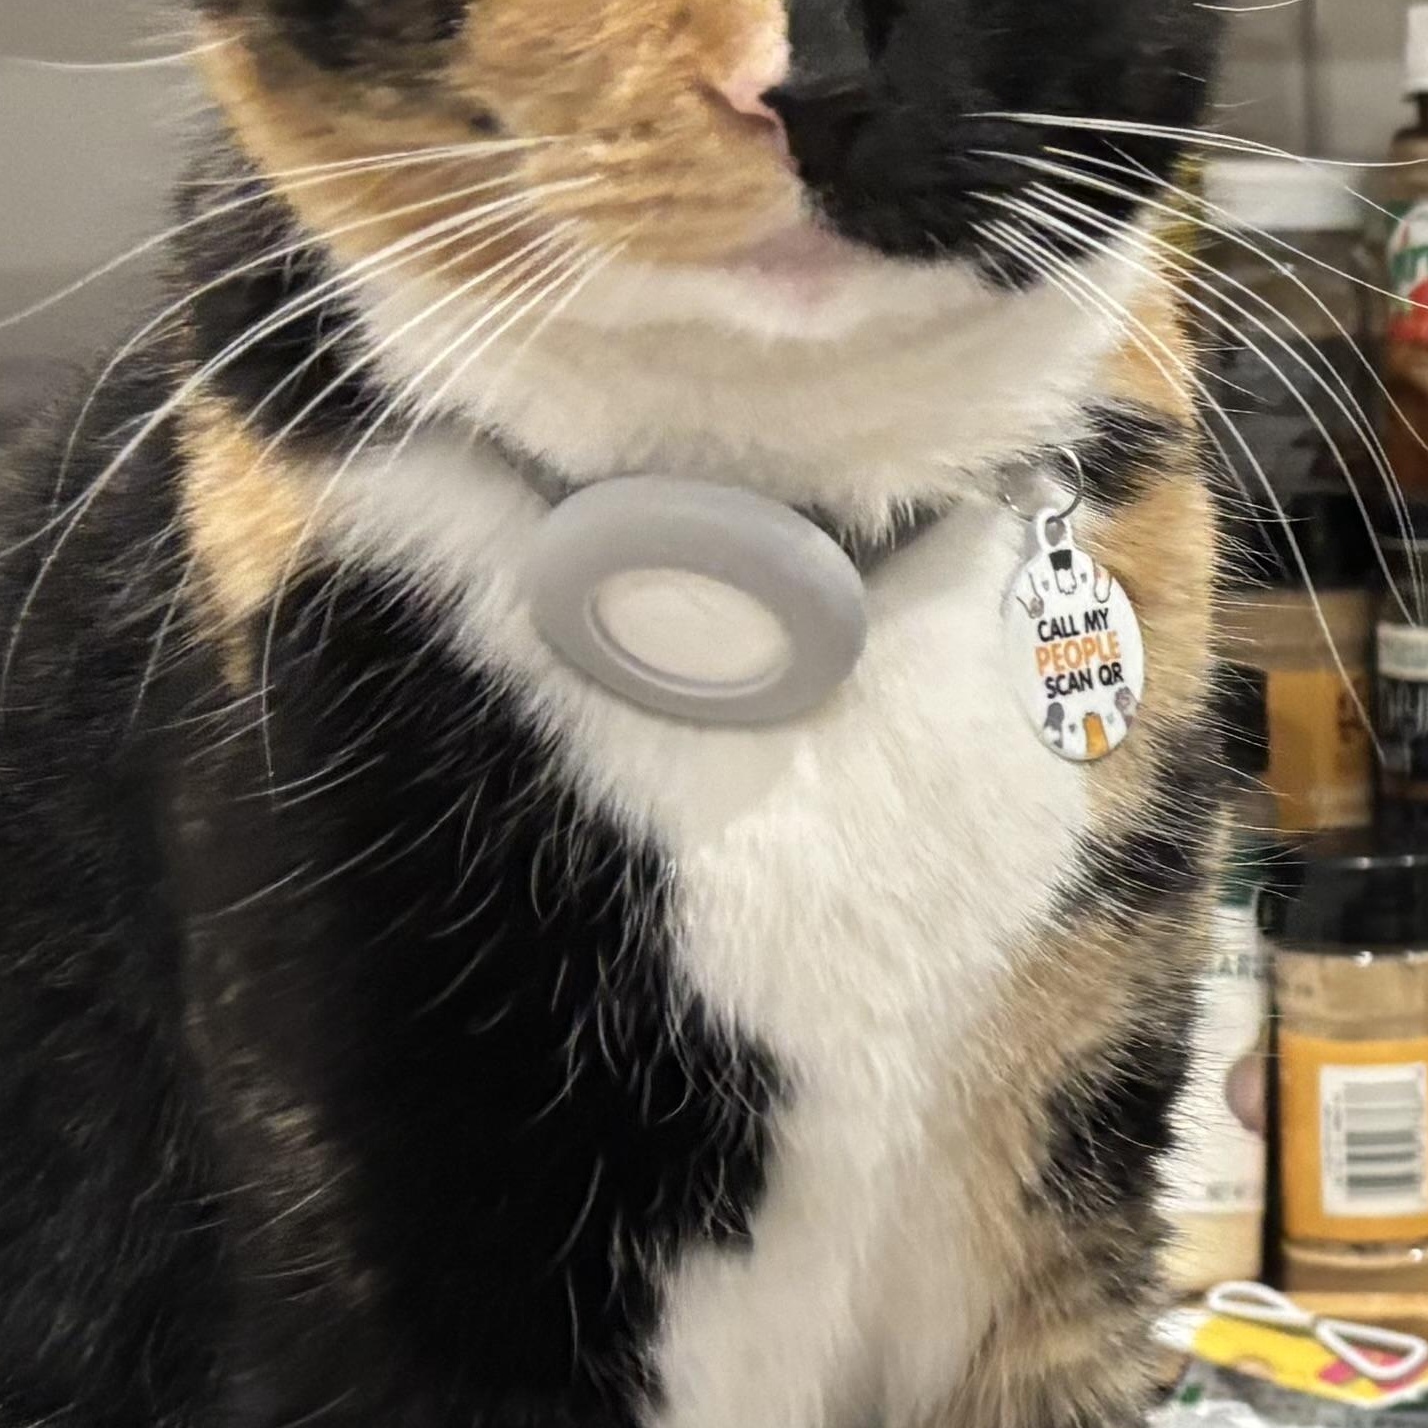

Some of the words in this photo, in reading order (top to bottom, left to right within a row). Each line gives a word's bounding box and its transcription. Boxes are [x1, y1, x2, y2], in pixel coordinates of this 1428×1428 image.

[1037, 614, 1081, 643] CALL
[1084, 607, 1109, 634] MY
[1034, 630, 1122, 677] PEOPLE
[1044, 667, 1094, 700] SCAN
[1098, 661, 1125, 687] QR
